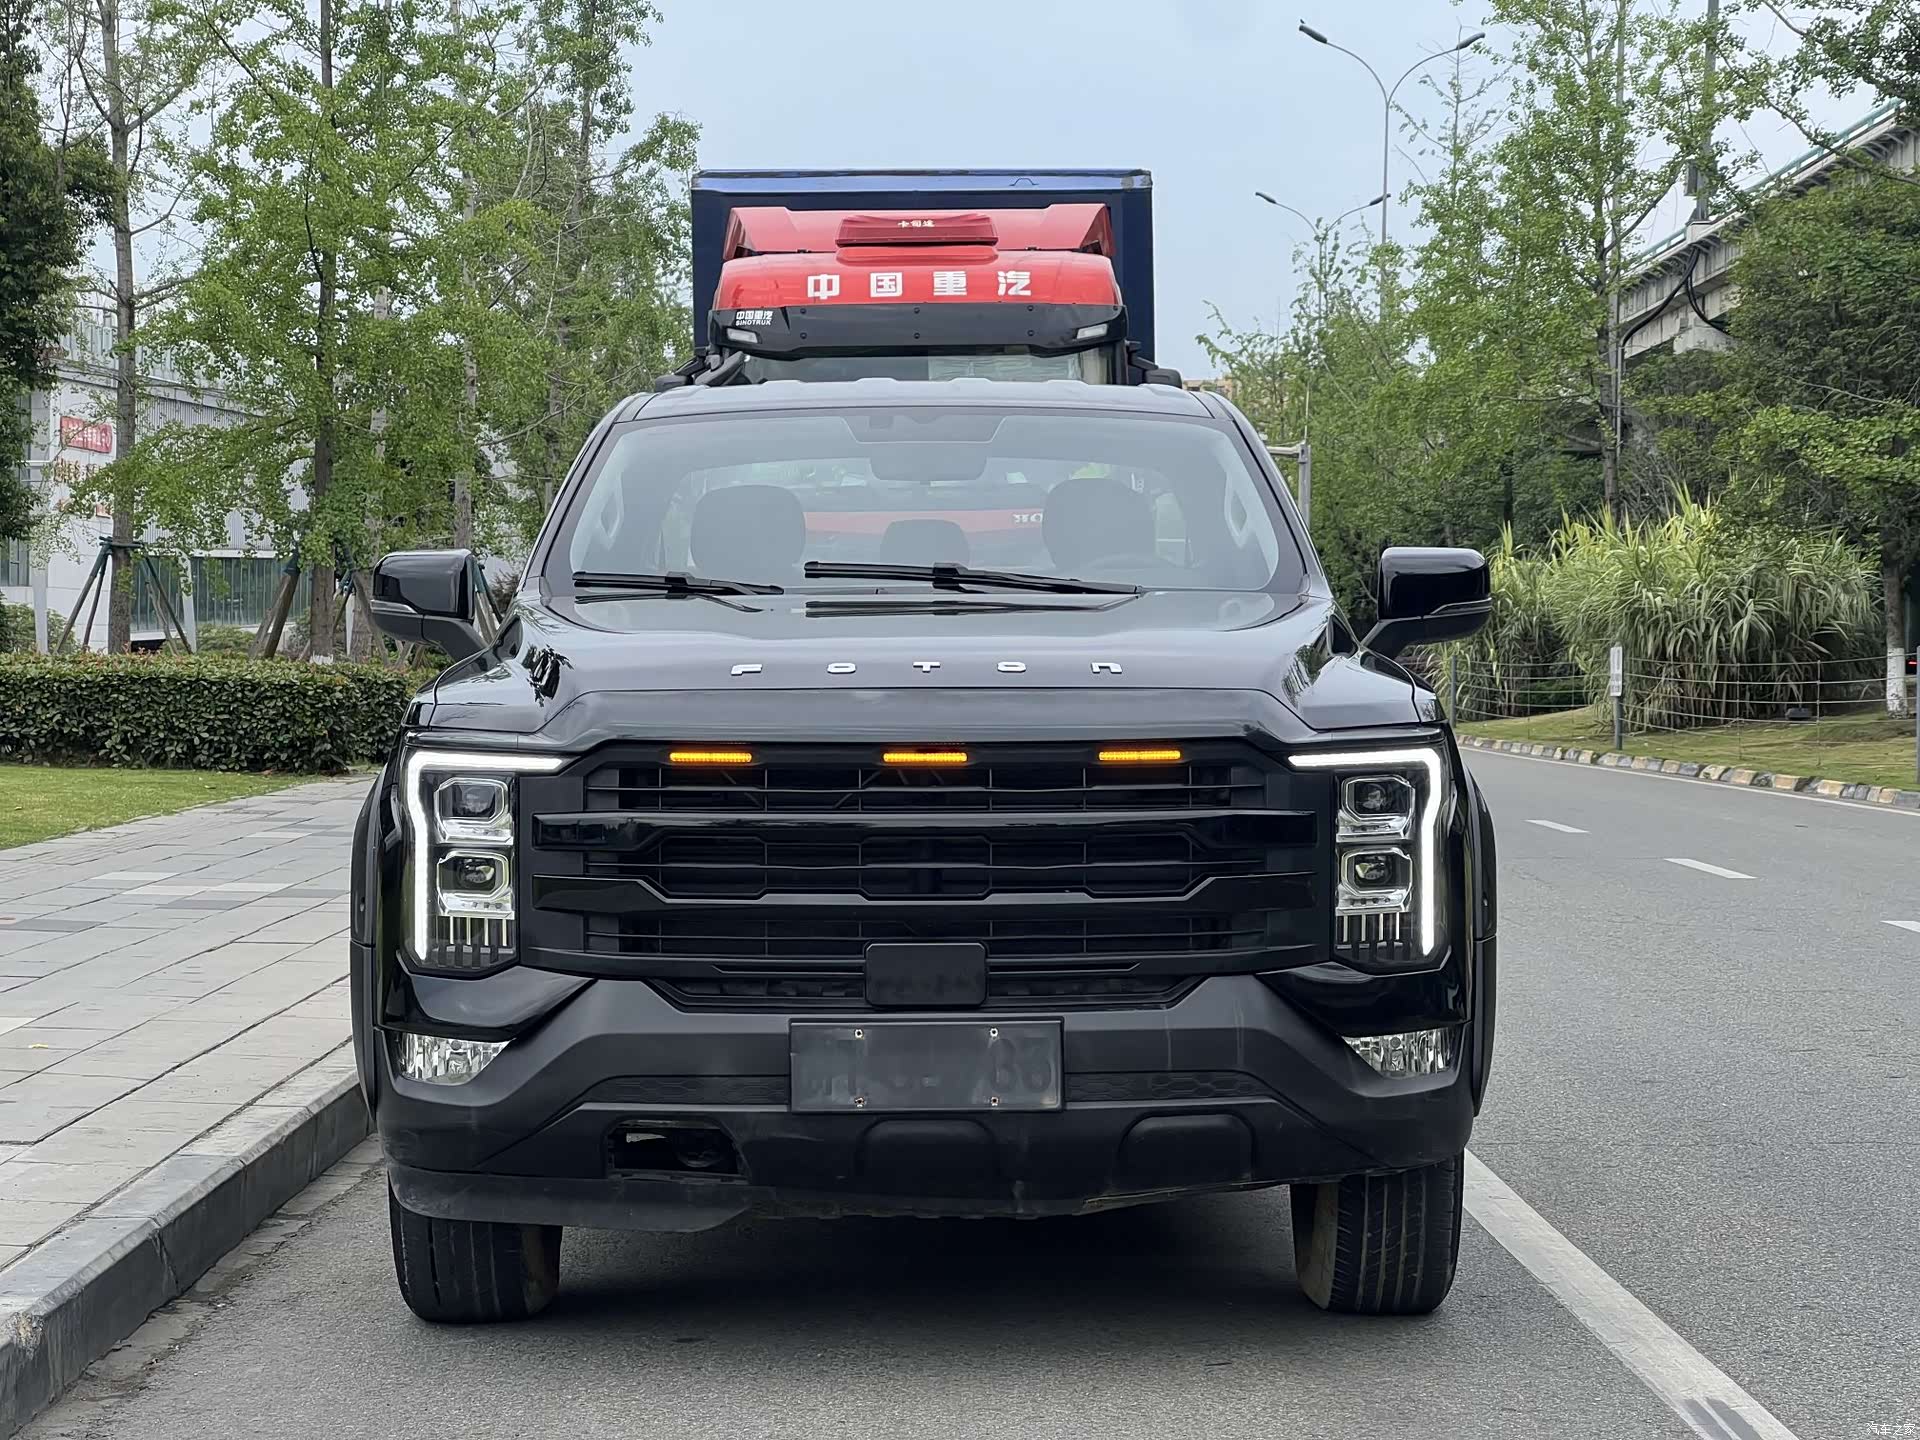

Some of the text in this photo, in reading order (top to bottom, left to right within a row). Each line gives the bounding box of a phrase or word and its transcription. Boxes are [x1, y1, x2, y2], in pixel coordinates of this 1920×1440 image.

[807, 270, 1032, 300] 中国重汽
[735, 310, 774, 320] 中国重汽
